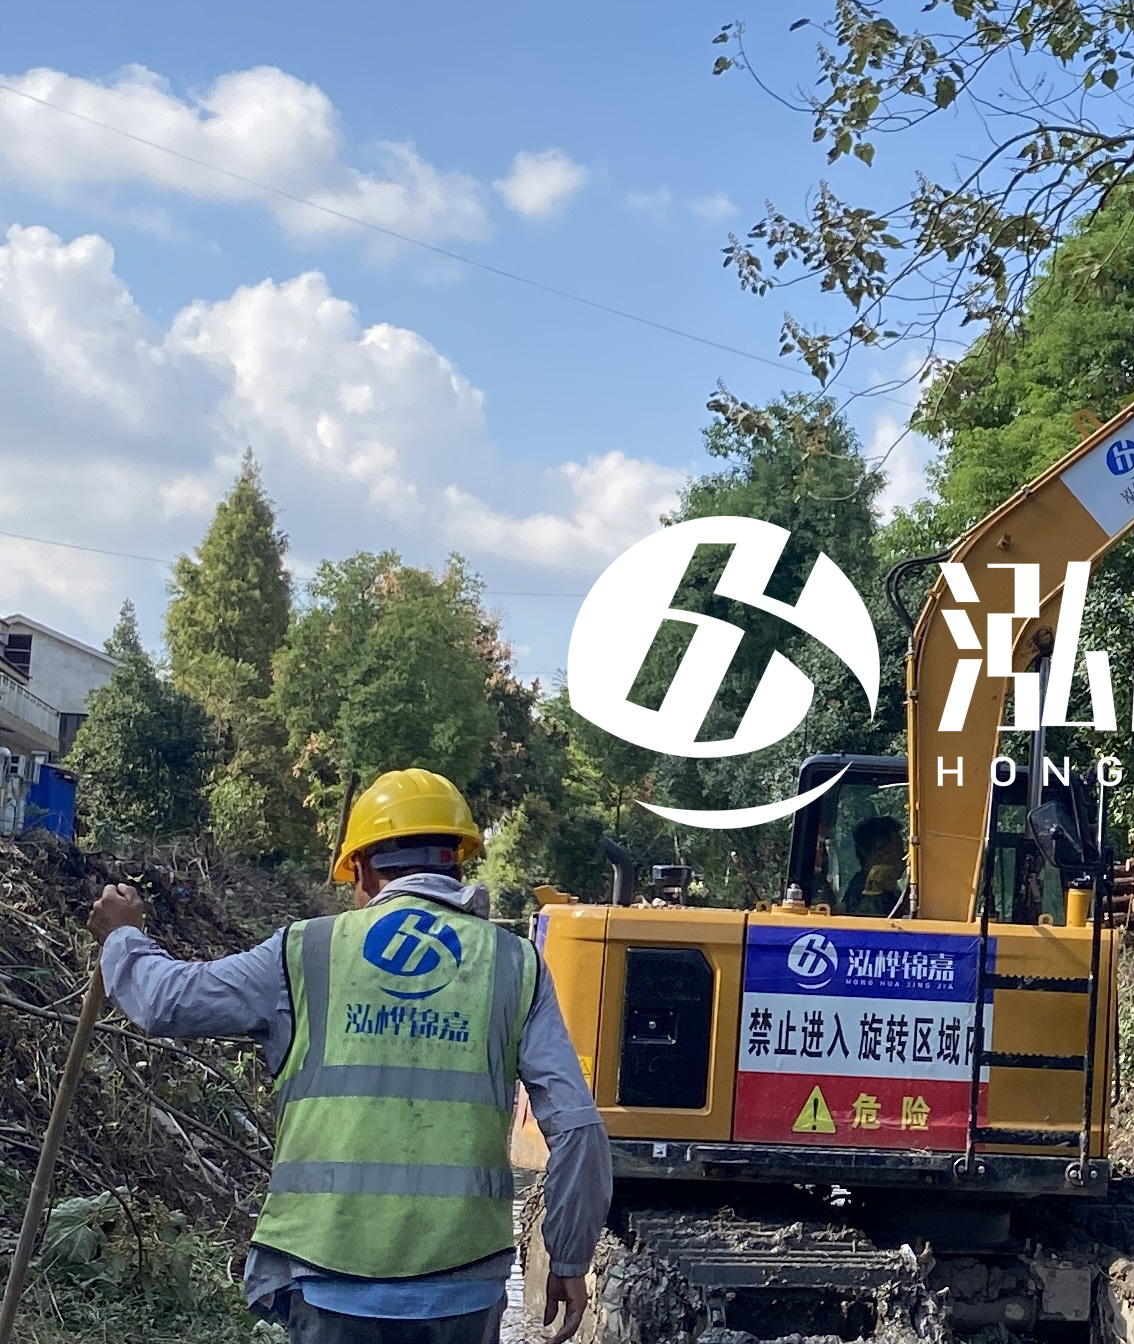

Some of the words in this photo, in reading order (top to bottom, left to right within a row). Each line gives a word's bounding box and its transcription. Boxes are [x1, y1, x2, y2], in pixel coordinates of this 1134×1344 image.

[846, 949, 955, 982] 泓桦锦嘉
[851, 1092, 931, 1131] 危险
